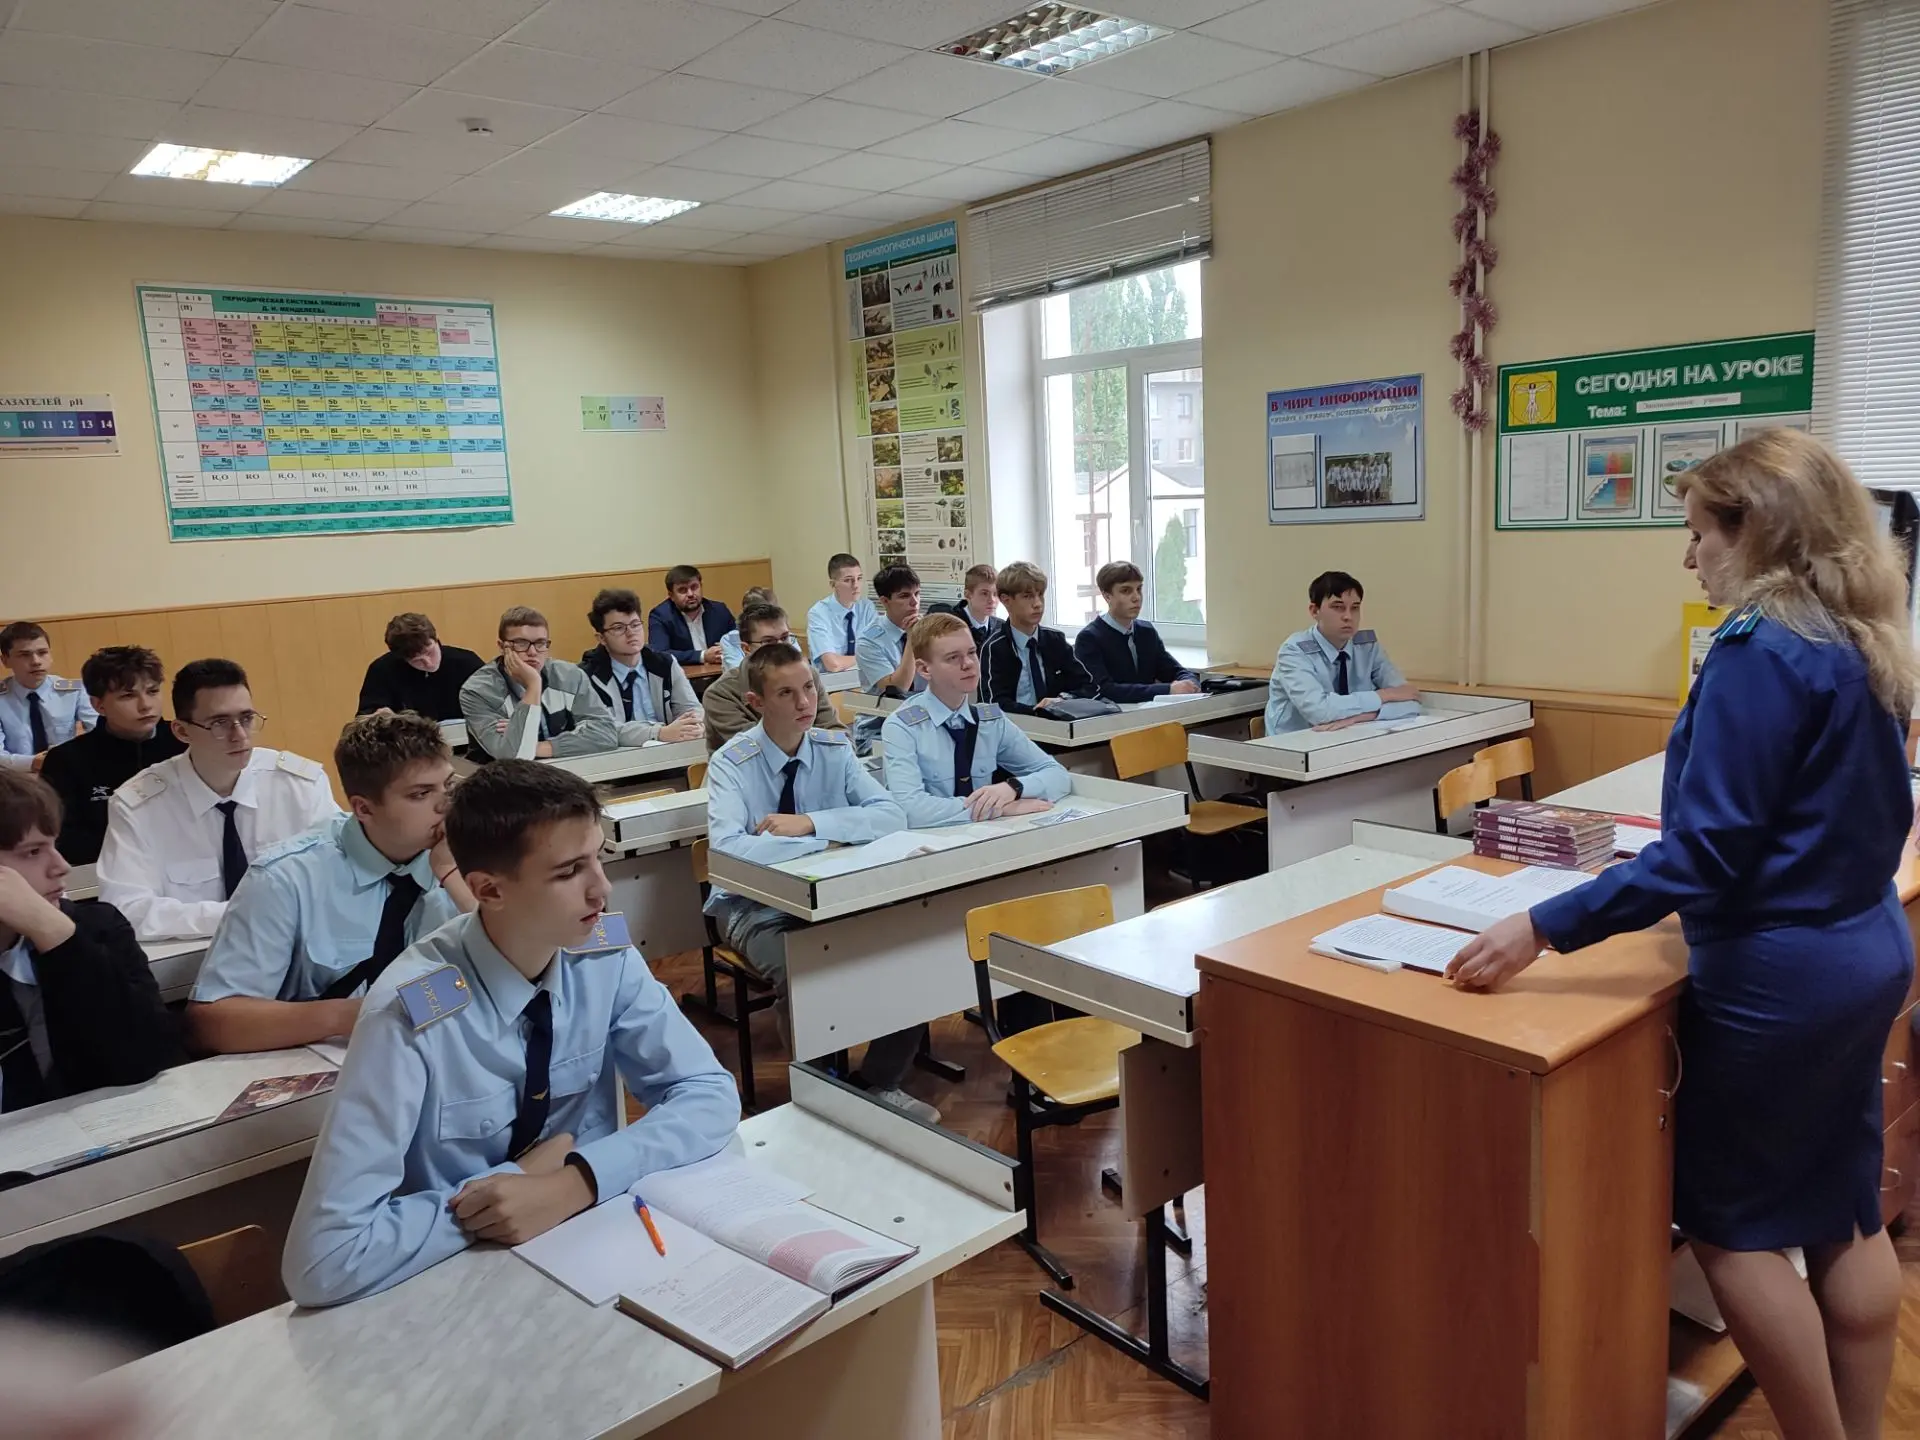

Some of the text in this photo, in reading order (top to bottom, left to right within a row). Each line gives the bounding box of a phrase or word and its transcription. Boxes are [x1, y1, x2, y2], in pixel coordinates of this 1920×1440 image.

[927, 227, 954, 242] ШКАЛА
[222, 295, 284, 304] ПЕРИОДИЧЕСКАЯ
[1575, 354, 1803, 394] СЕГОДНЯ НА УРОКЕ
[69, 398, 83, 407] pH
[1272, 384, 1418, 411] В МИРЕ ИНФОРМАЦИИ
[1587, 405, 1627, 419] Тема:
[4, 420, 112, 429] 9 10 11 12 13 14
